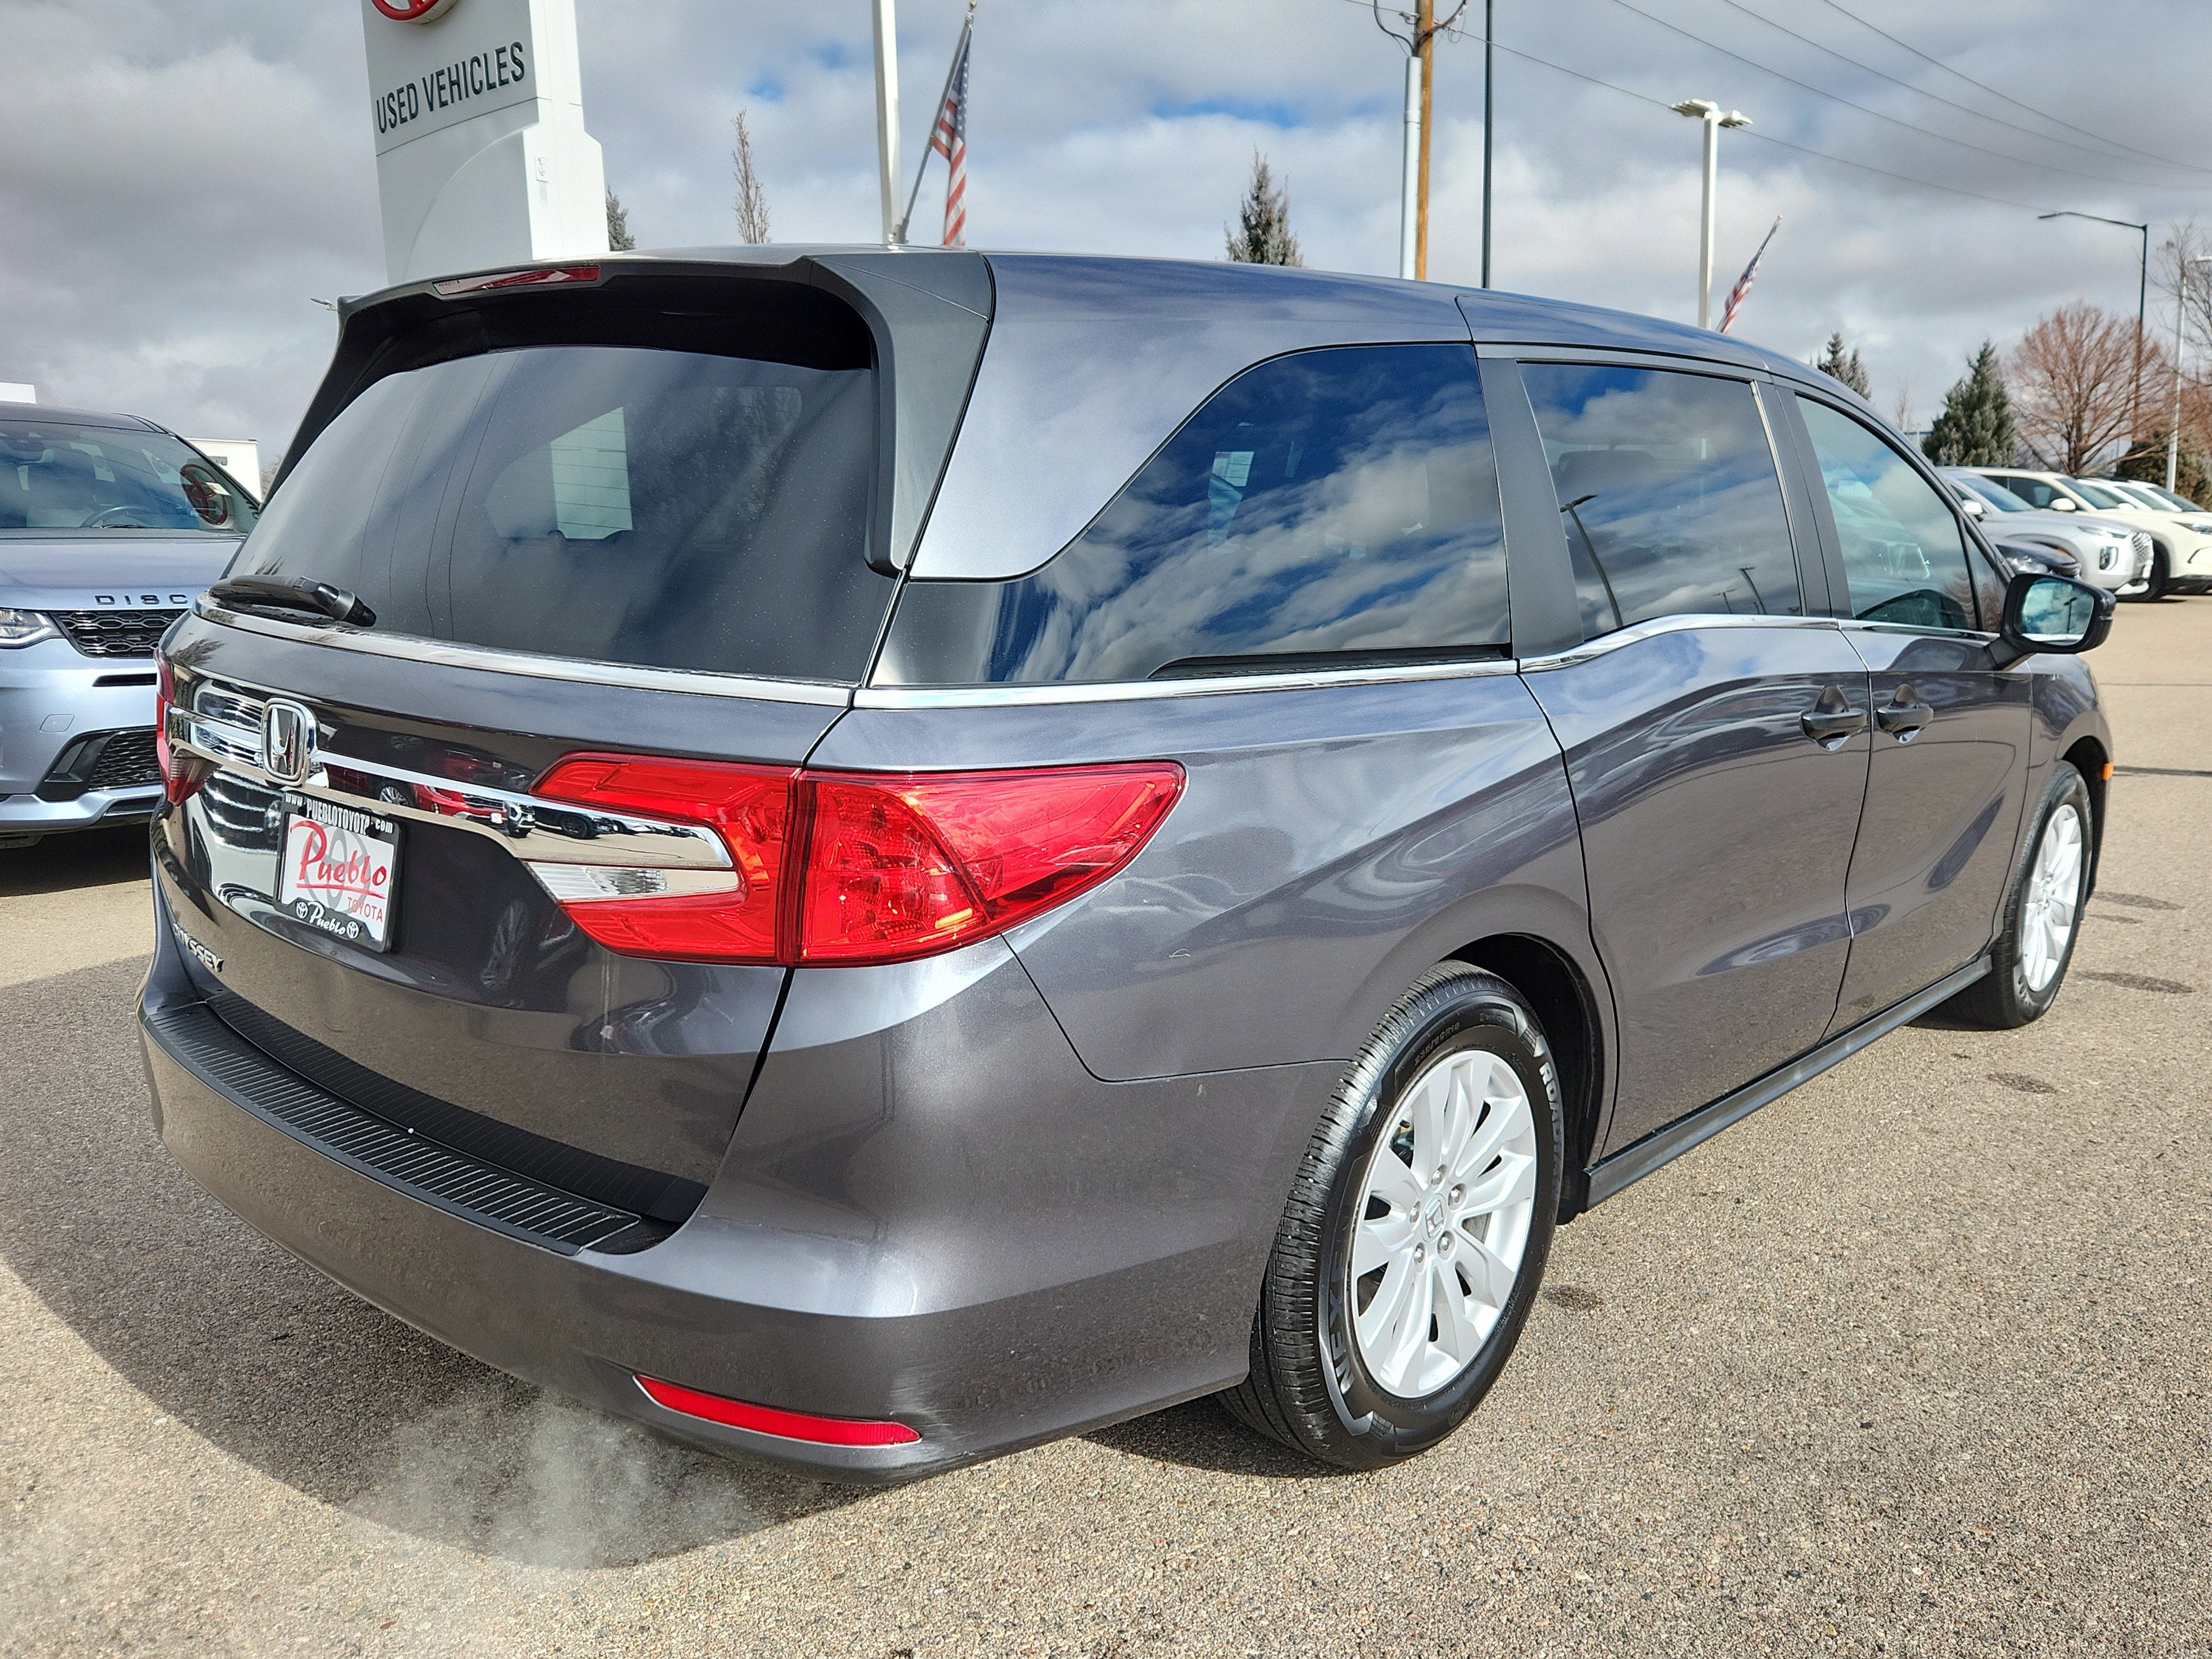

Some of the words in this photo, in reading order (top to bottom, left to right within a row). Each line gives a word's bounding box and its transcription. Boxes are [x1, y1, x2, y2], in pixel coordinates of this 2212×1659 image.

[376, 82, 418, 134] USED
[422, 41, 525, 112] VEHICLES
[290, 820, 387, 886] Pueblo
[308, 901, 347, 935] Pueblo
[348, 897, 383, 923] TOYOTA
[1329, 1223, 1355, 1396] NEXE
